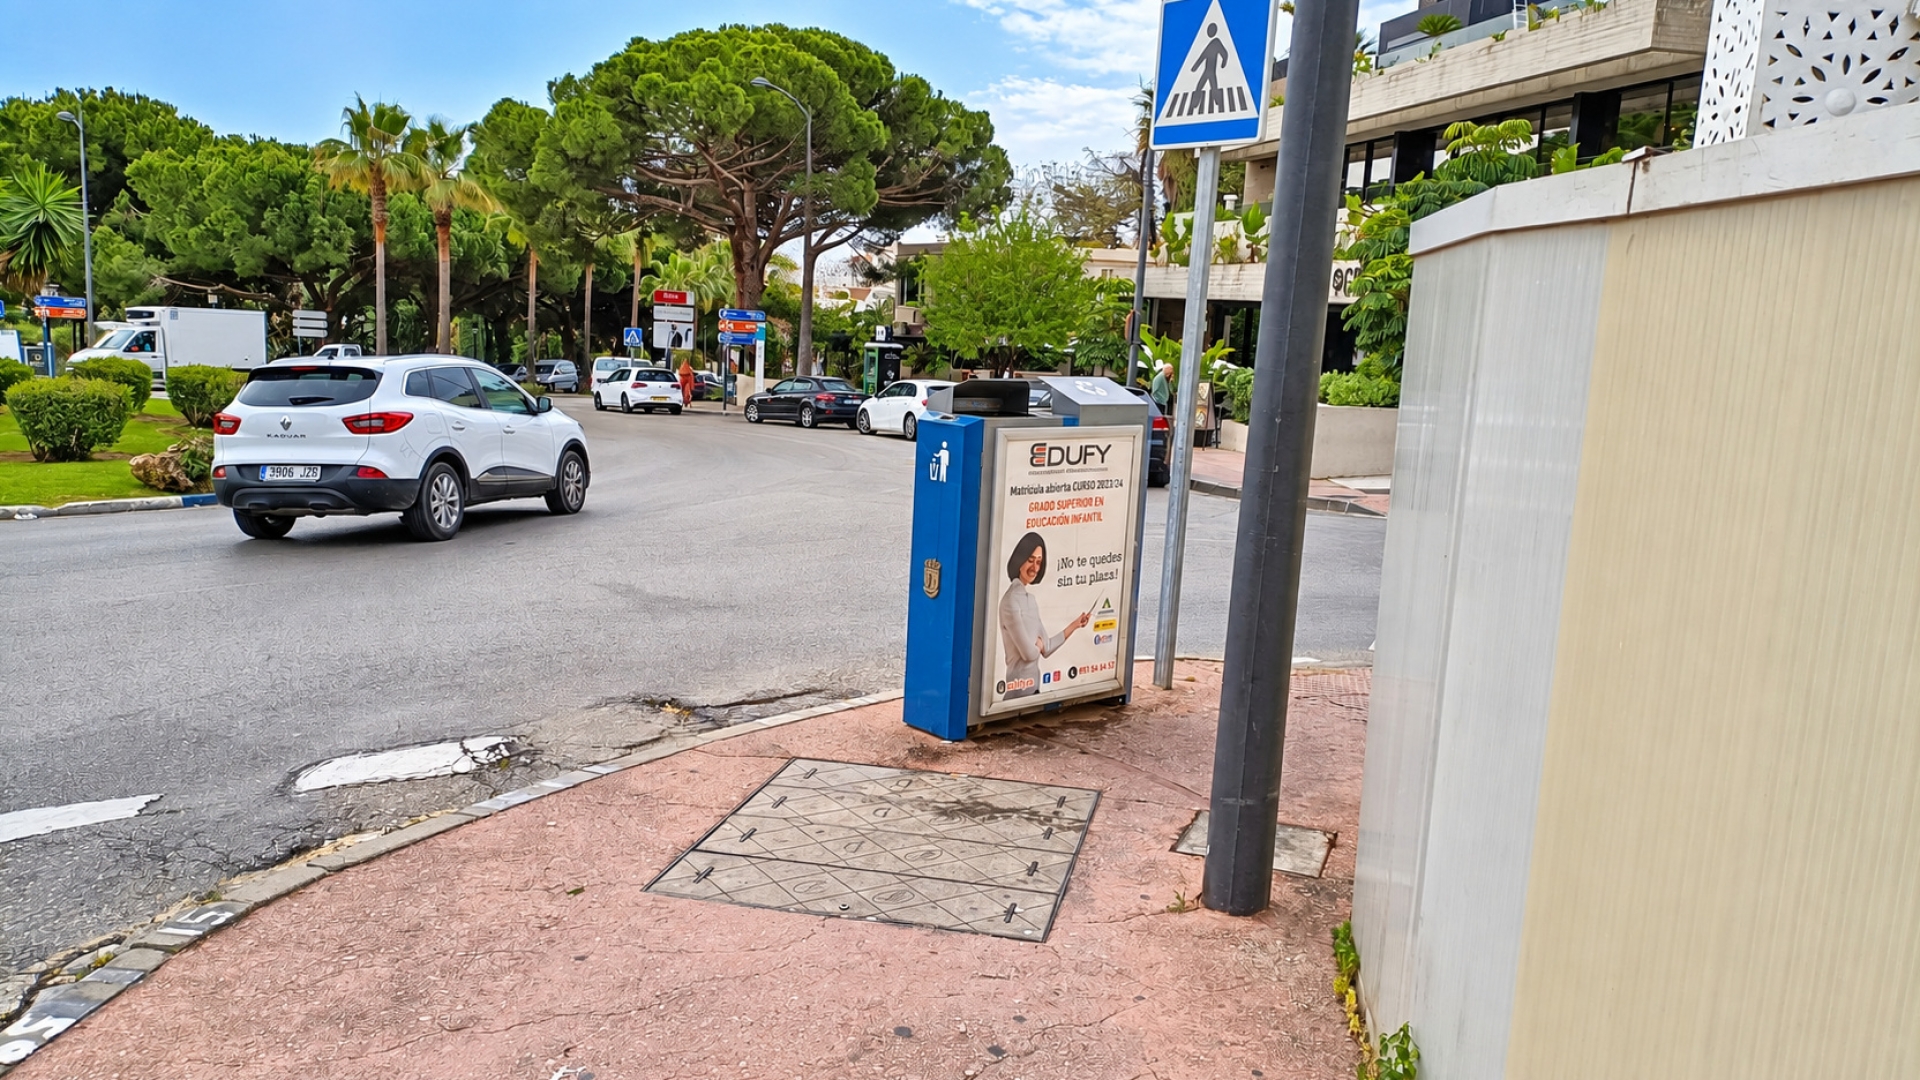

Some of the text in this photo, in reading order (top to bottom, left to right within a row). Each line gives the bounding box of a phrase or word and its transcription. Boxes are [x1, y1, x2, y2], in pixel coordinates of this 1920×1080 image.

[1029, 442, 1112, 468] EDUFY
[269, 466, 294, 478] 3906
[1045, 482, 1071, 493] abierta
[1072, 480, 1096, 491] CURSO
[1028, 496, 1105, 512] GRADO SUPERIOR EN
[1026, 511, 1104, 529] EDUCACIÓN INFANTIL
[1057, 552, 1123, 571] ¡No te quedes
[1057, 575, 1073, 587] sin
[1075, 574, 1087, 585] tu
